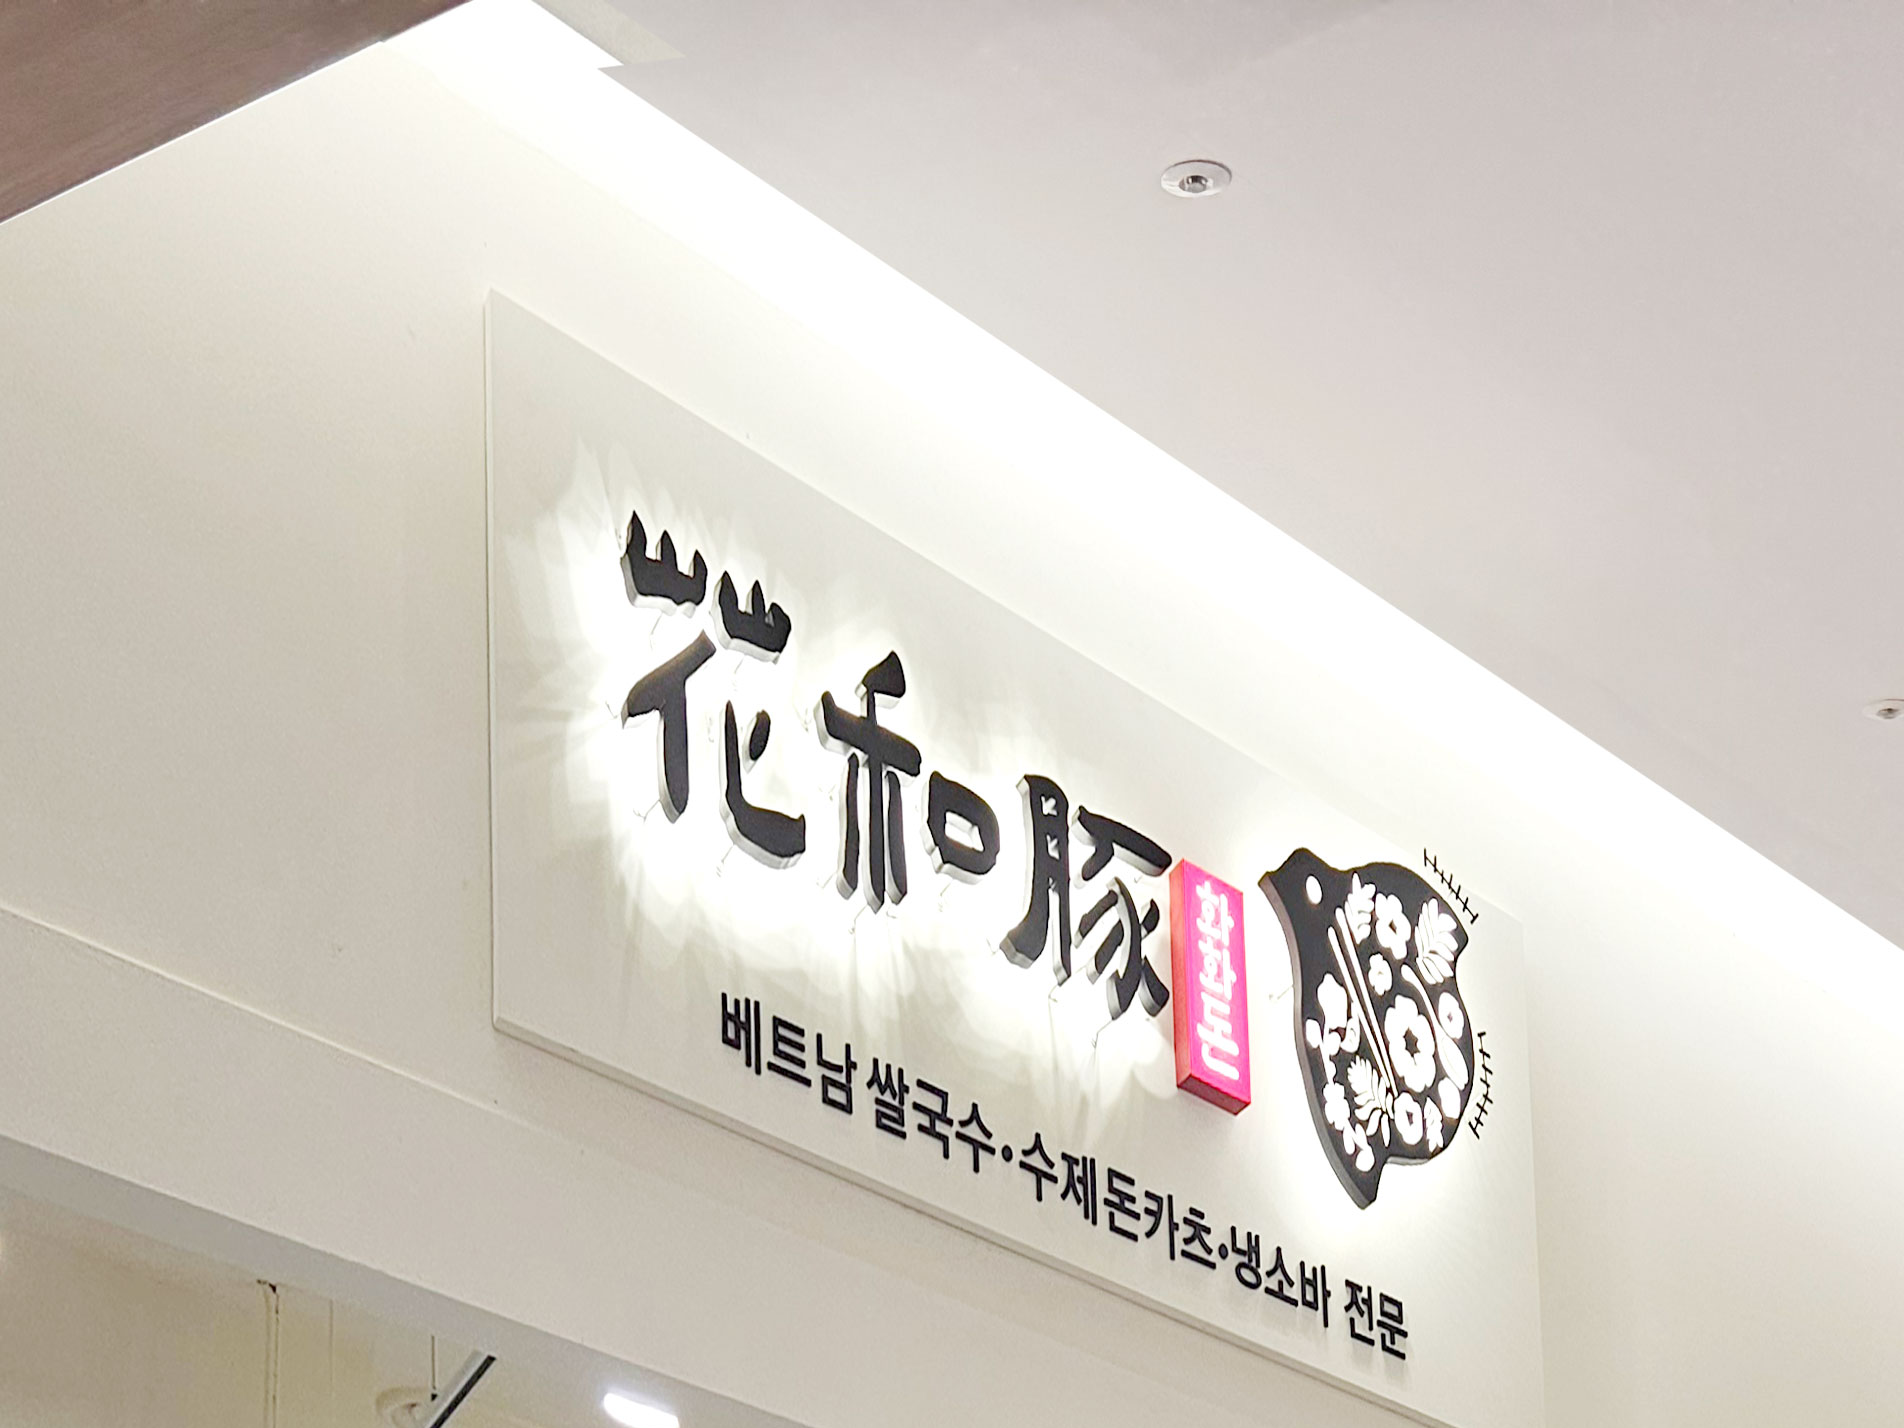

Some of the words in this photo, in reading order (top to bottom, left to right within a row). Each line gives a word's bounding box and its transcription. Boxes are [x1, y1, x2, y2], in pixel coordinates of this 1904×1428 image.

[618, 510, 1173, 1022] 花和豚
[1196, 880, 1240, 1081] 화화돈
[719, 991, 856, 1116] 베트남
[1343, 1277, 1410, 1360] 전문
